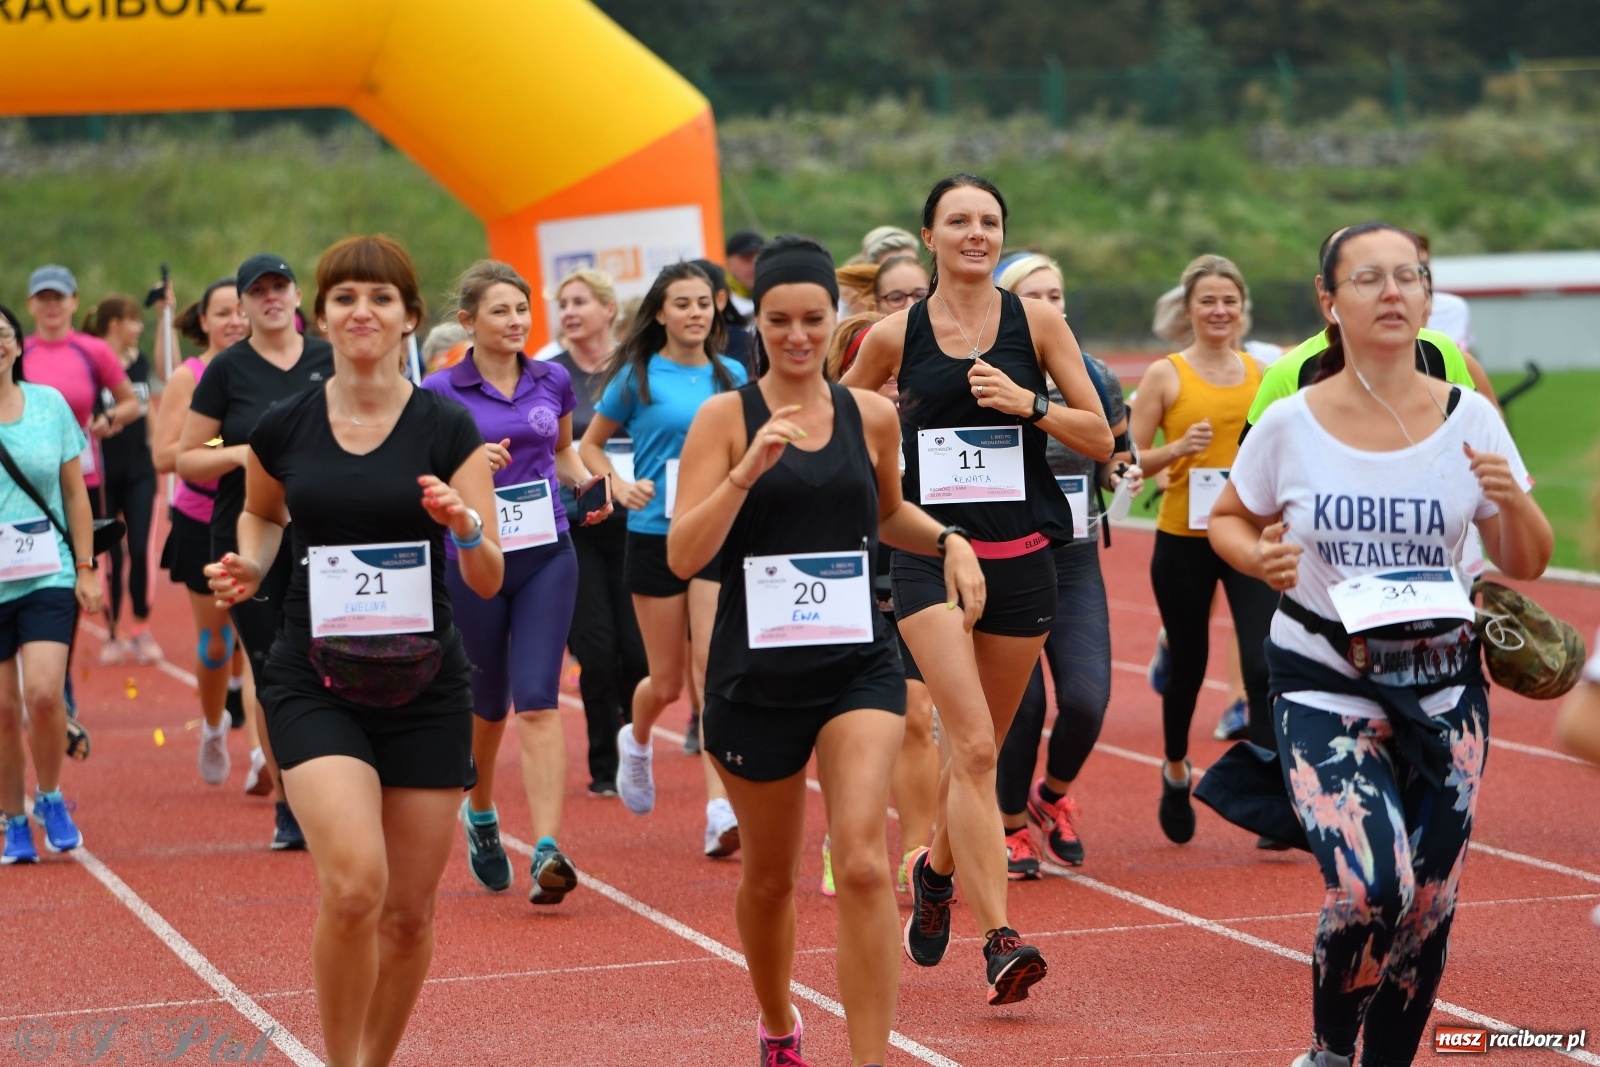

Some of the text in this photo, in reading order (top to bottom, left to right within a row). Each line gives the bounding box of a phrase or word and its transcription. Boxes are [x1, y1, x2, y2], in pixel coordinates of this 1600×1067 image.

[958, 449, 986, 470] 11
[952, 474, 992, 484] RENATA
[500, 504, 523, 524] 15
[1313, 494, 1445, 537] KOBIETA
[15, 535, 35, 554] 29
[1316, 539, 1445, 567] NIEZALEŻNA
[355, 571, 388, 596] 21
[793, 581, 827, 605] 20
[1381, 583, 1417, 600] 34
[345, 601, 387, 613] EWELINA
[792, 610, 820, 622] EWA
